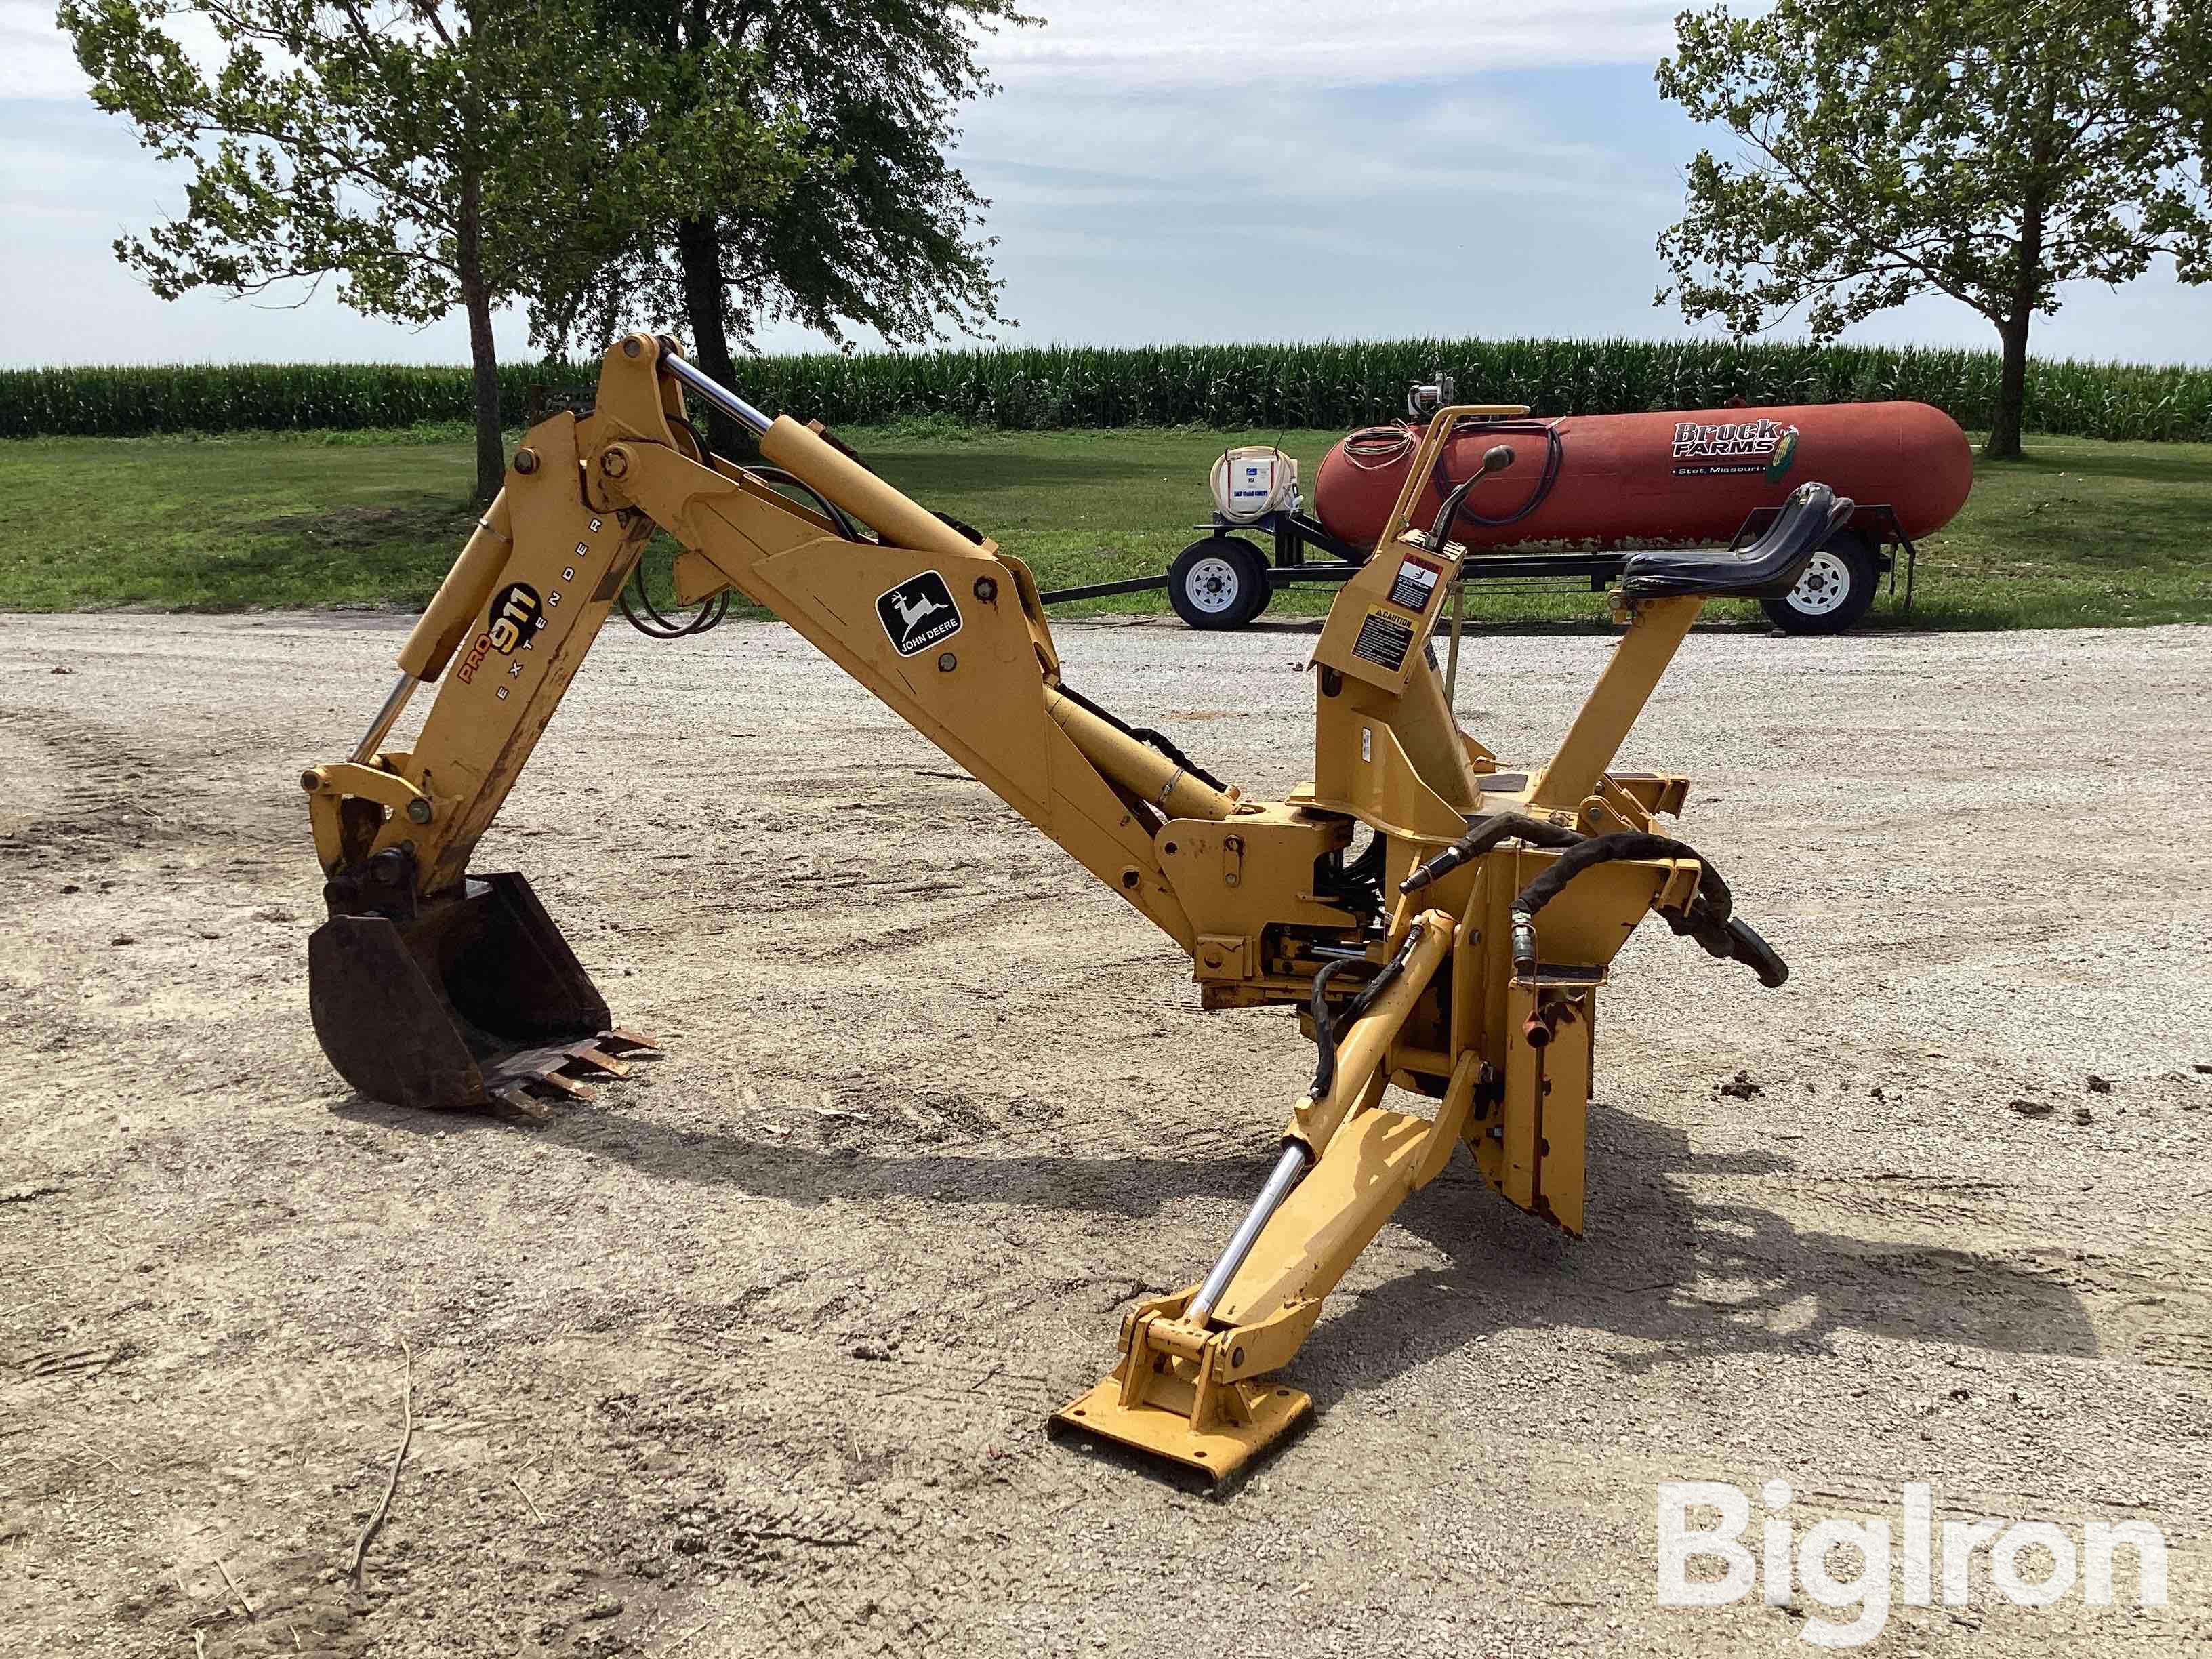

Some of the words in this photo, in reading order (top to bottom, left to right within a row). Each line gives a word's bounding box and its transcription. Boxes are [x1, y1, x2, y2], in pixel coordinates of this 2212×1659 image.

[1674, 419, 1782, 443] Brock
[1672, 441, 1775, 457] FARMS
[497, 518, 602, 699] EXTENDER
[1382, 611, 1412, 628] CAUTION
[457, 633, 493, 684] PRO
[489, 587, 537, 656] 911
[902, 634, 927, 652] JOHN
[927, 618, 958, 639] DEERE
